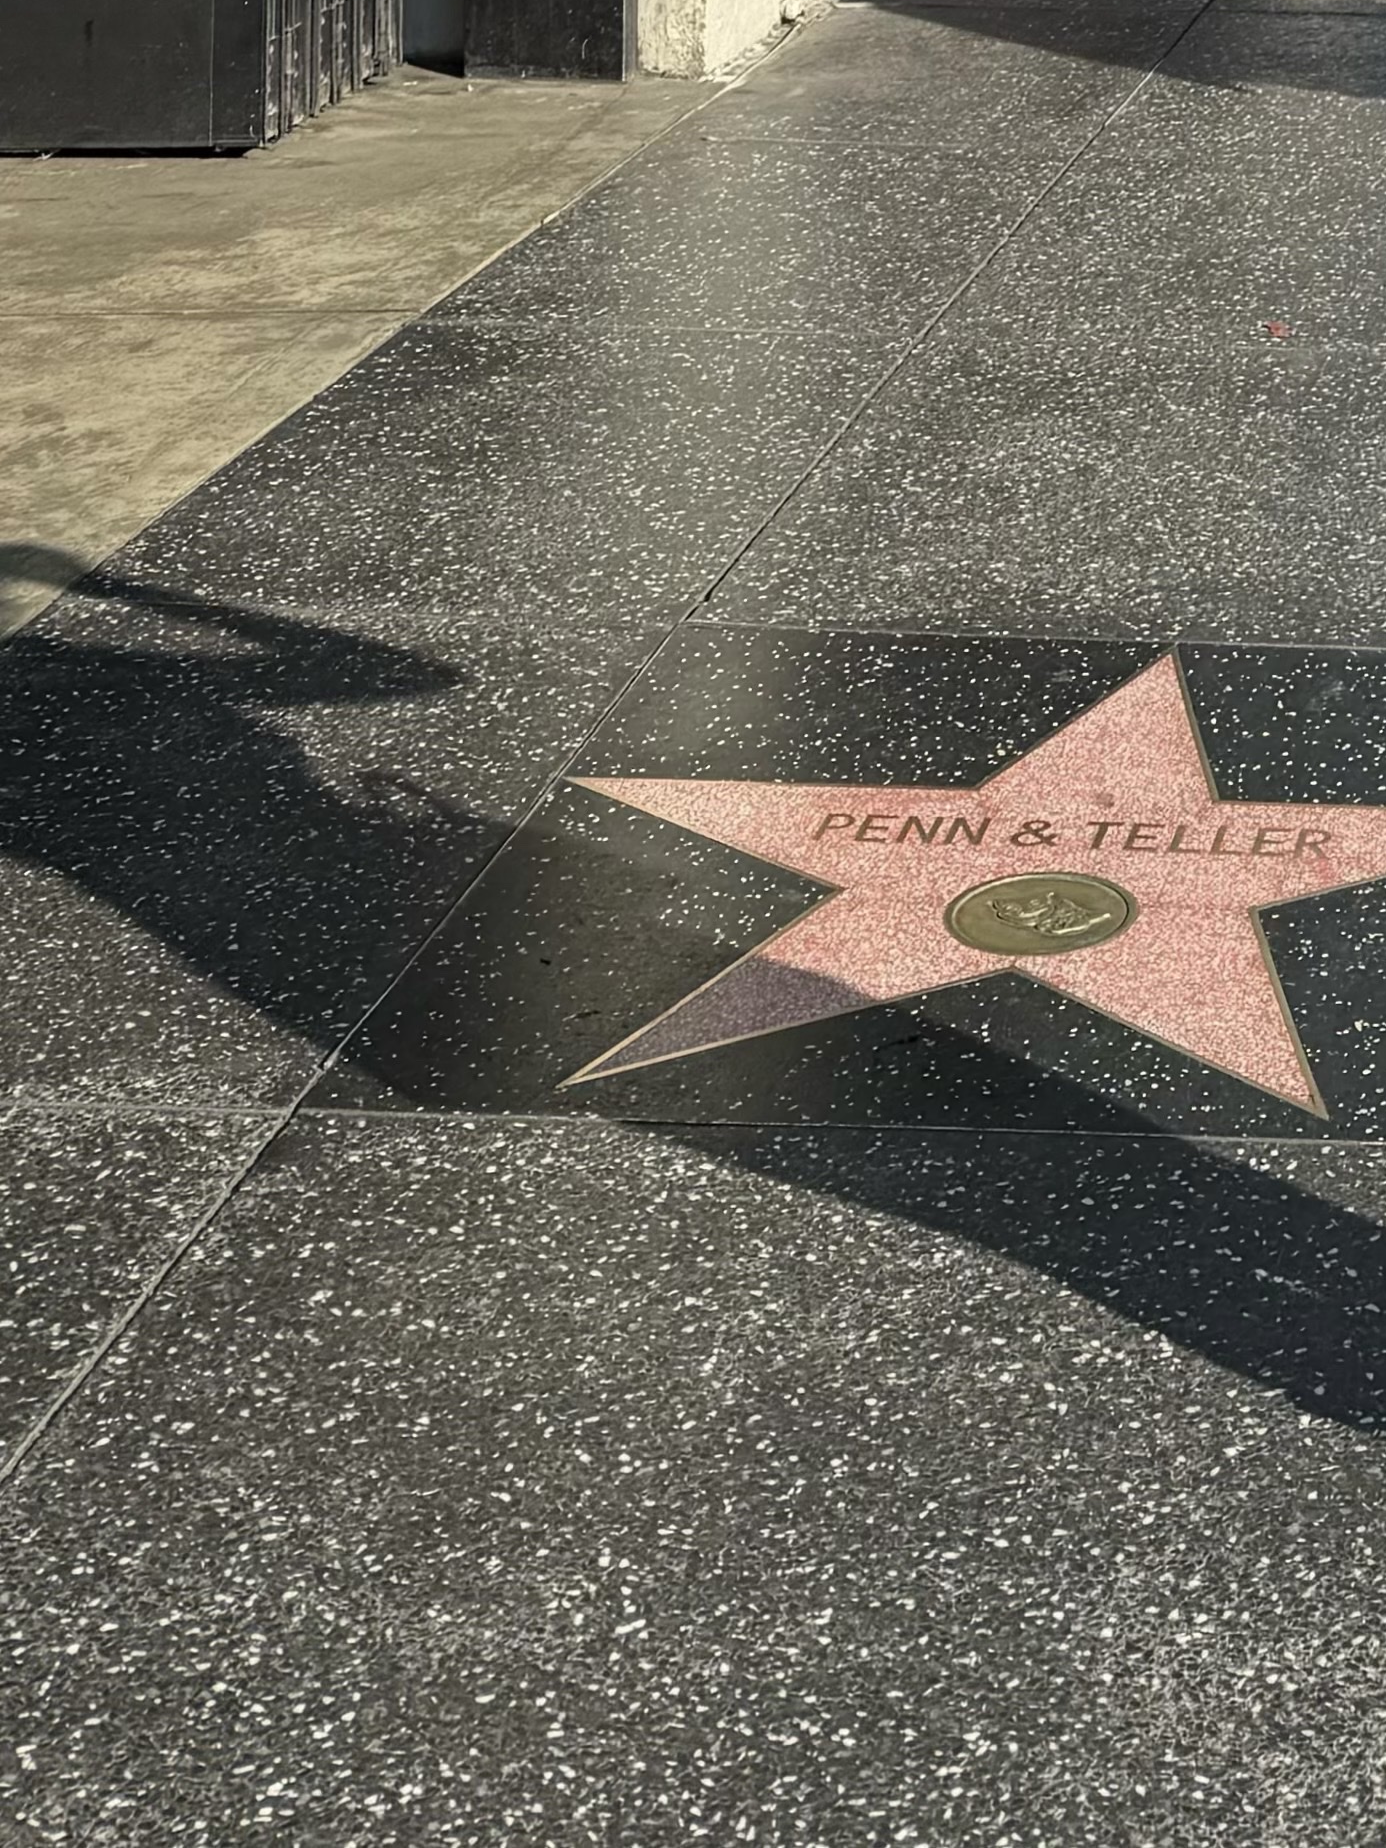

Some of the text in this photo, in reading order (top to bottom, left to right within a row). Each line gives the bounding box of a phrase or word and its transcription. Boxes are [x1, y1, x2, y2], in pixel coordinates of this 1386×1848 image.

[812, 812, 1335, 861] PENN & TELLER
